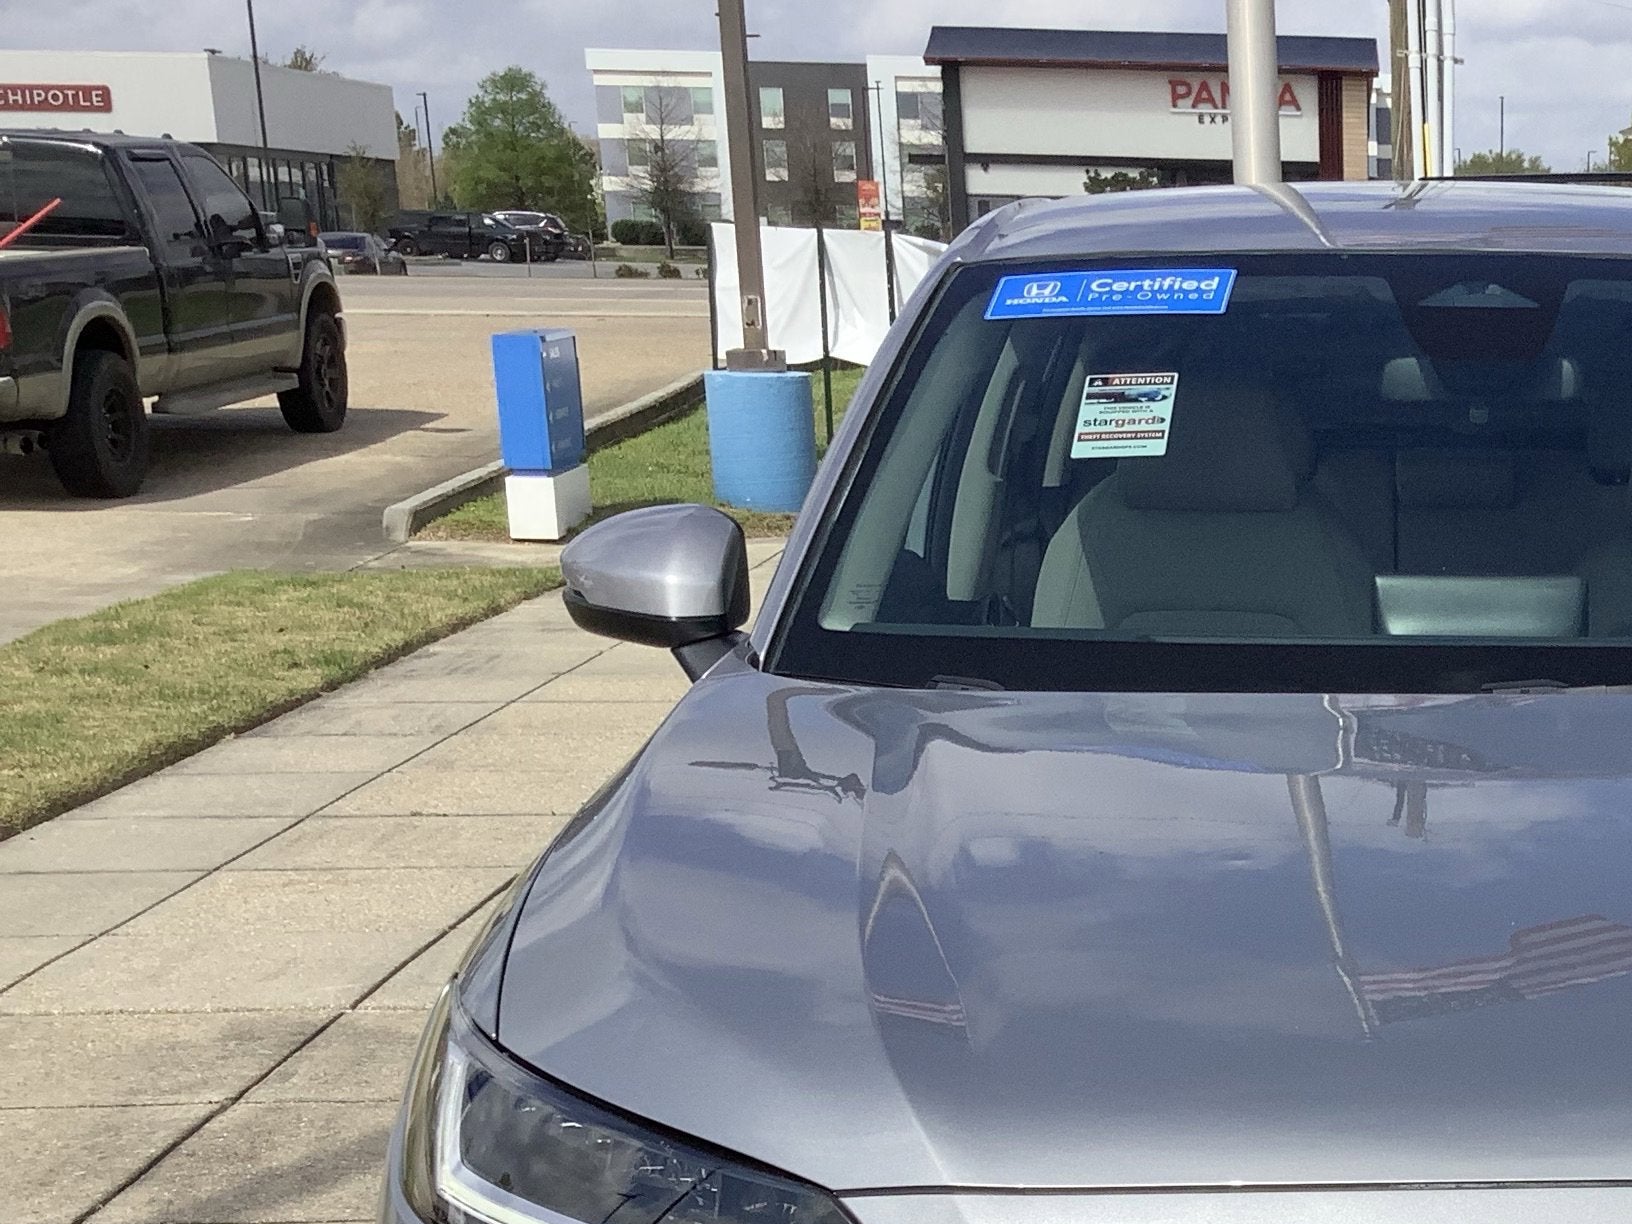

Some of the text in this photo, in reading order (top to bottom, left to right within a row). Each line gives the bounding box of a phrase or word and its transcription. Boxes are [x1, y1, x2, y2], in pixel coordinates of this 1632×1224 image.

[1168, 79, 1301, 111] PAA
[1090, 276, 1219, 292] Certified
[1005, 296, 1069, 305] HONDA
[1087, 291, 1214, 302] Pre-Owned
[1112, 376, 1172, 386] ATTENTION
[1082, 415, 1157, 428] stargard
